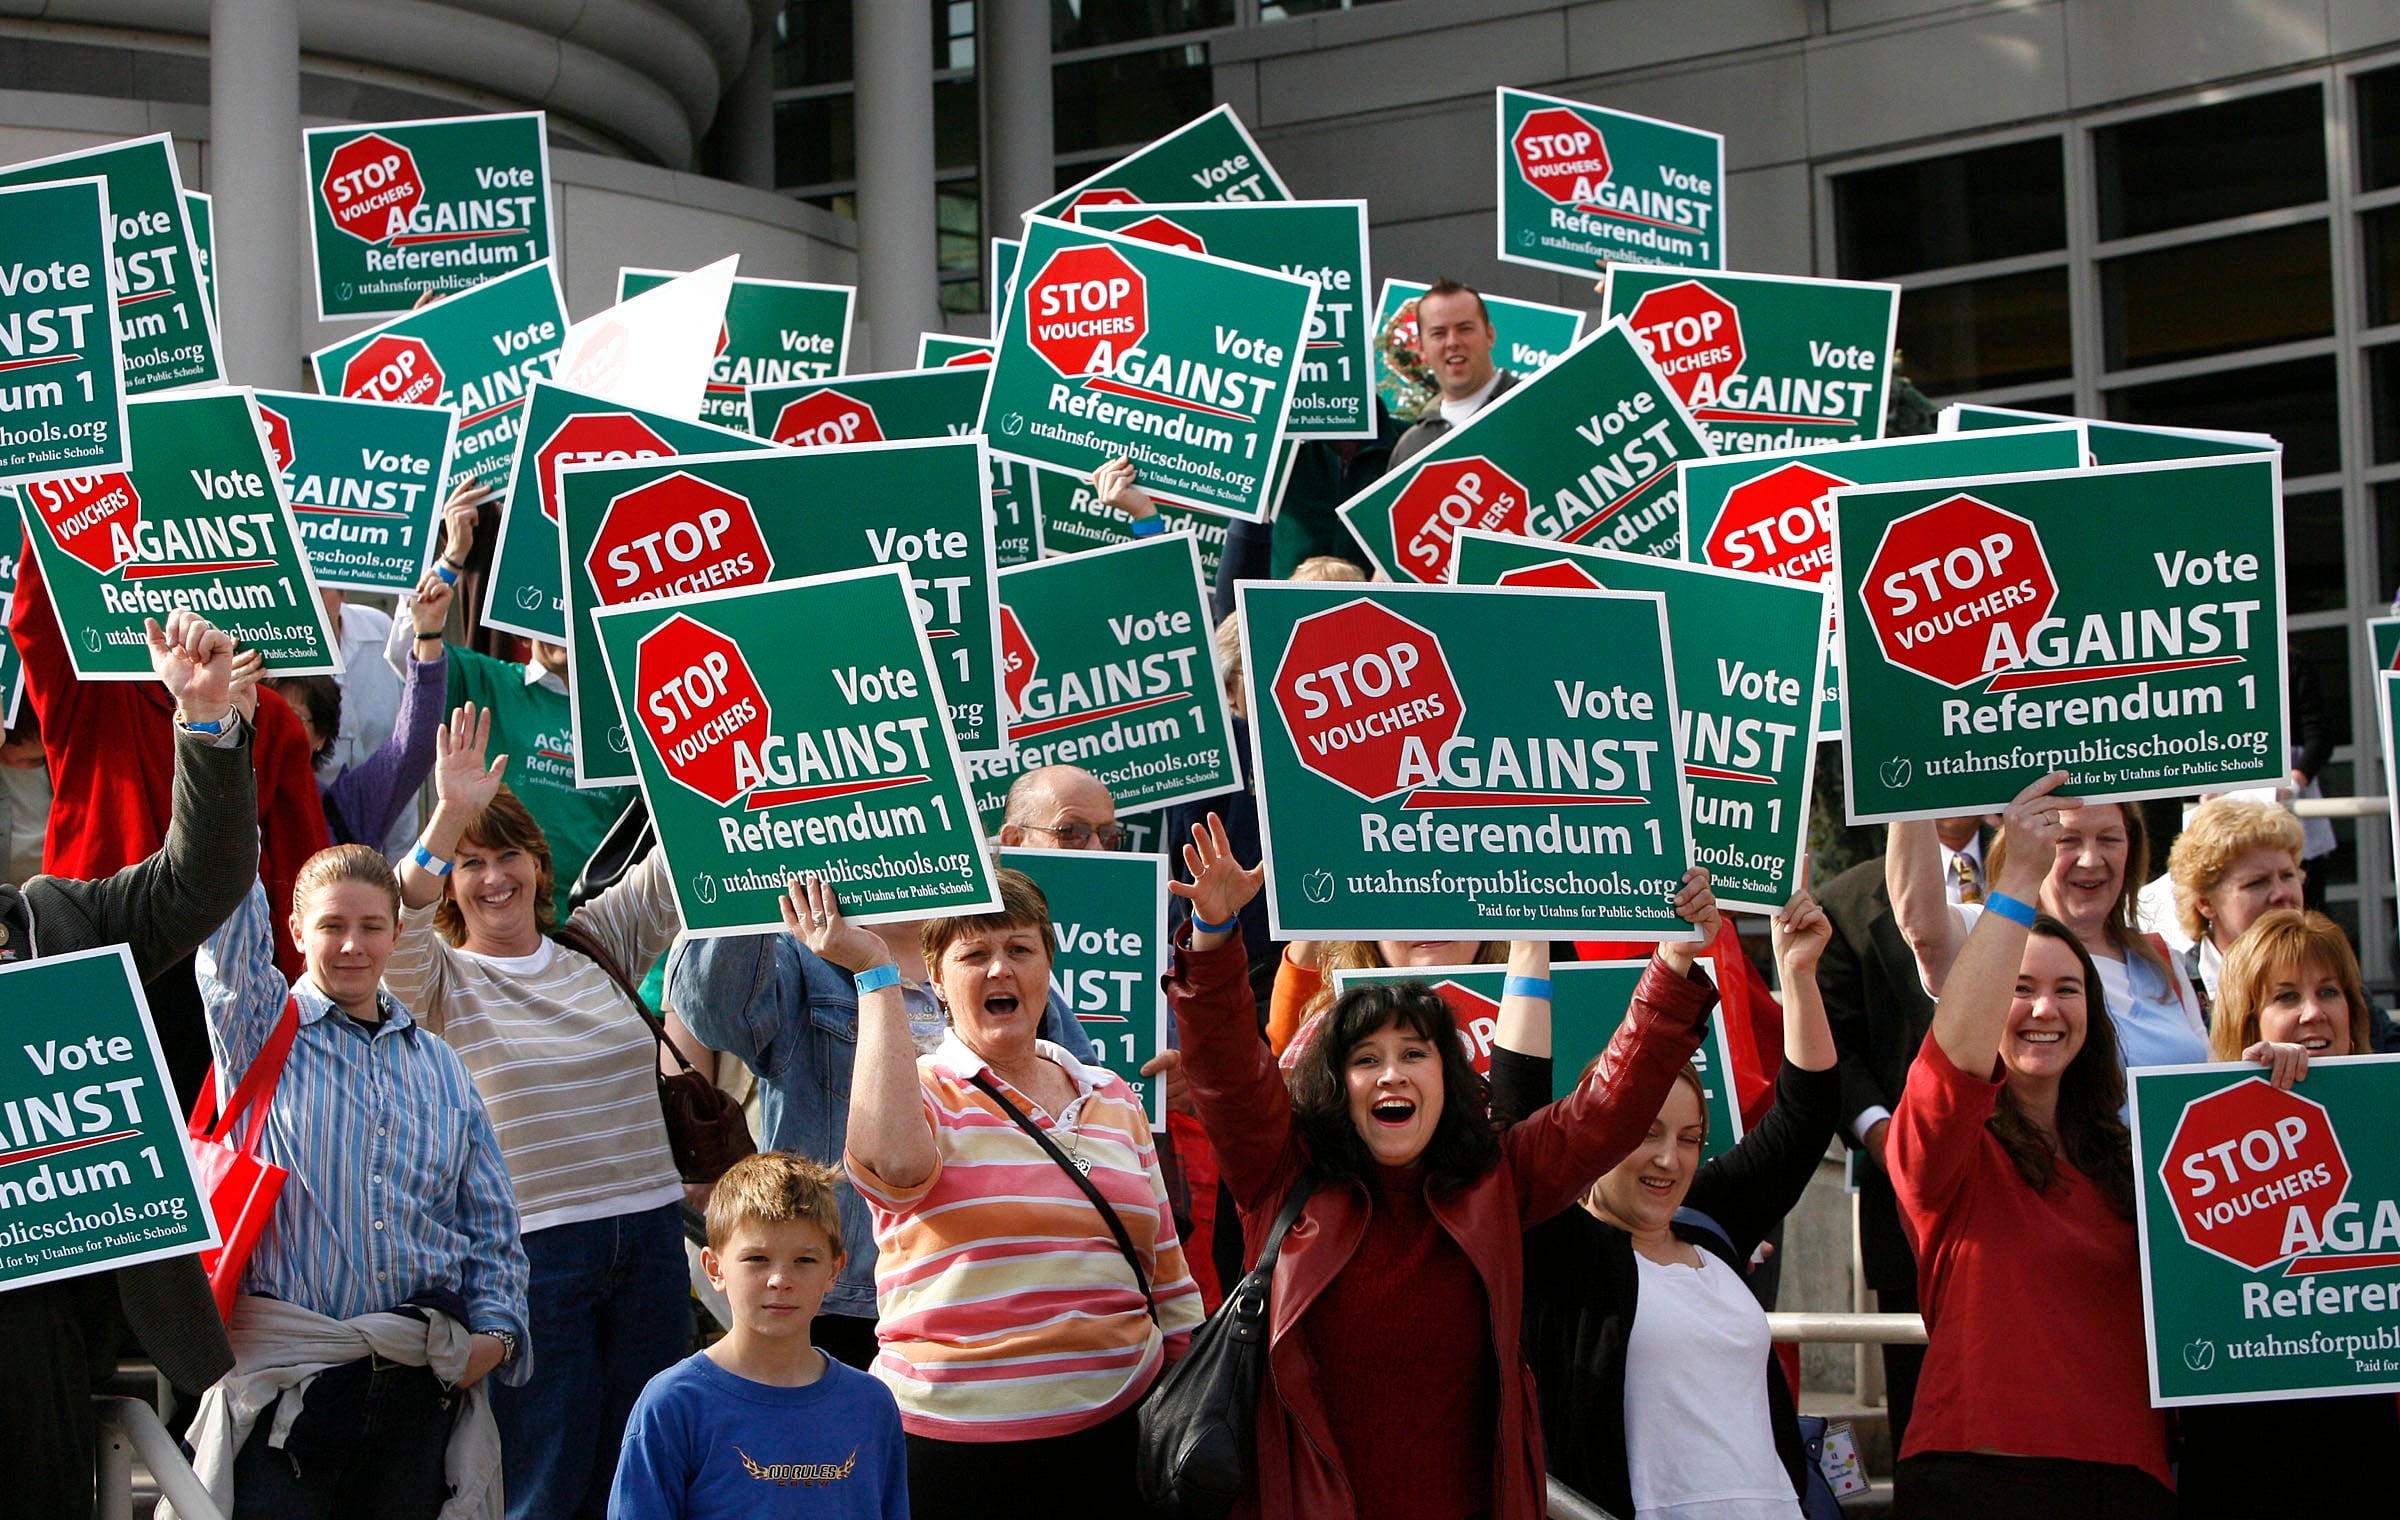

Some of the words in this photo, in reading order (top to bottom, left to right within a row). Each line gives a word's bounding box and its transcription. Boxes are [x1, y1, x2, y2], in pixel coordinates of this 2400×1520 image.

[1525, 133, 1590, 158] STOP
[333, 155, 400, 202] STOP
[475, 166, 533, 188] Vote
[1192, 155, 1250, 189] Vote
[1529, 160, 1601, 177] VOUCHERS
[1659, 166, 1711, 194] Vote
[339, 182, 414, 221] VOUCHERS
[386, 196, 535, 235] AGAINST
[1572, 176, 1711, 228] AGAINST
[1551, 208, 1692, 256] Referendum
[1700, 242, 1709, 260] 1
[366, 242, 517, 271] Referendum
[525, 241, 535, 261] 1
[0, 262, 90, 297] Vote
[1040, 279, 1130, 315] STOP
[173, 304, 189, 330] 1
[1038, 317, 1135, 341] VOUCHERS
[1635, 310, 1723, 356] STOP
[493, 321, 555, 356] Vote
[781, 330, 834, 353] Vote
[1216, 325, 1282, 366] Vote
[1810, 341, 1875, 370] Vote
[711, 355, 832, 384] GAINST
[1084, 340, 1276, 414] AGAINST
[1338, 357, 1349, 381] 1
[1660, 345, 1733, 377] UCHERS
[76, 372, 93, 403] 1
[1688, 372, 1872, 416] AGAINST
[1048, 383, 1231, 454] Referendum
[1244, 434, 1257, 459] 1
[1575, 392, 1655, 446] Vote
[10, 454, 25, 465] for
[27, 450, 60, 463] Public
[63, 445, 103, 459] Schools
[362, 448, 430, 474] Vote
[1030, 421, 1254, 493] utahnsforpublicschools.org
[190, 468, 263, 500] Vote
[1138, 468, 1149, 480] by
[1150, 472, 1177, 486] Utahns
[1178, 479, 1189, 489] for
[1190, 482, 1215, 496] Public
[1215, 489, 1245, 504] Schools
[1524, 419, 1679, 540] GAINST
[54, 487, 129, 542] VOUCHERS
[1006, 501, 1020, 525] 1
[1411, 472, 1483, 568] STOP
[109, 513, 276, 562] AGAINST
[400, 527, 412, 547] 1
[607, 508, 730, 587] STOP
[865, 527, 967, 563] Vote
[1883, 532, 2013, 617] STOP
[2153, 549, 2258, 588] Vote
[99, 577, 275, 613] Referendum
[278, 578, 296, 607] 1
[1894, 578, 2037, 650] VOUCHERS
[1108, 610, 1190, 645] Vote
[1981, 599, 2259, 672] AGAINST
[262, 649, 287, 659] Public
[286, 648, 316, 658] Schools
[951, 650, 969, 683] 1
[648, 651, 728, 736] STOP
[831, 664, 917, 705] Vote
[1294, 642, 1418, 718] STOP
[1553, 680, 1653, 719] Vote
[1718, 657, 1800, 706] Vote
[1308, 693, 1445, 755] VOUCHERS
[1942, 681, 2222, 736] Referendum
[2238, 676, 2254, 710] 1
[667, 697, 757, 769] VOUCHERS
[968, 720, 1180, 783] Referendum
[1189, 707, 1205, 734] 1
[1680, 709, 1797, 773] INST
[732, 716, 930, 790] AGAINST
[1397, 736, 1658, 790] AGAINST
[1924, 733, 2267, 776] utahnsforpublicschools.org
[2064, 772, 2078, 786] aid
[2085, 771, 2100, 783] for
[2103, 770, 2117, 784] by
[2120, 767, 2160, 780] Utahns
[2163, 764, 2179, 777] for
[2182, 761, 2217, 775] Public
[2220, 758, 2262, 772] Schools
[1141, 784, 1154, 794] for
[1155, 777, 1183, 791] Public
[1185, 770, 1218, 785] Schools
[717, 800, 926, 854] Referendum
[931, 796, 951, 832] 1
[1360, 811, 1631, 854] Referendum
[1644, 819, 1662, 855] 1
[1767, 800, 1781, 834] 1
[839, 891, 852, 903] for
[851, 891, 862, 905] by
[864, 888, 896, 901] Utahns
[896, 886, 909, 899] for
[909, 884, 938, 898] Public
[938, 881, 973, 896] Schools
[1346, 869, 1676, 903] utahnsforpublicschools.org
[1710, 875, 1739, 890] Public
[1741, 879, 1776, 894] Schools
[1477, 903, 1502, 916] Paid
[1505, 904, 1520, 916] for
[1523, 904, 1536, 920] by
[1539, 904, 1578, 917] Utahns
[1581, 905, 1596, 917] for
[1598, 906, 1632, 918] Public
[1634, 906, 1675, 918] Schools
[1052, 922, 1142, 957] Vote
[23, 1035, 132, 1076] Vote
[1119, 1035, 1134, 1063] 1
[0, 1077, 144, 1149] INST
[140, 1146, 164, 1179] 1
[2182, 1116, 2307, 1197] STOP
[2194, 1162, 2331, 1231] VOUCHERS
[5, 1255, 23, 1268] for
[23, 1253, 38, 1265] by
[41, 1245, 84, 1260] Utahns
[85, 1239, 103, 1251] for
[103, 1230, 142, 1248] Public
[142, 1222, 187, 1240] Schools
[2355, 1358, 2380, 1372] Paid
[768, 1464, 790, 1480] NO
[791, 1464, 837, 1480] RULES
